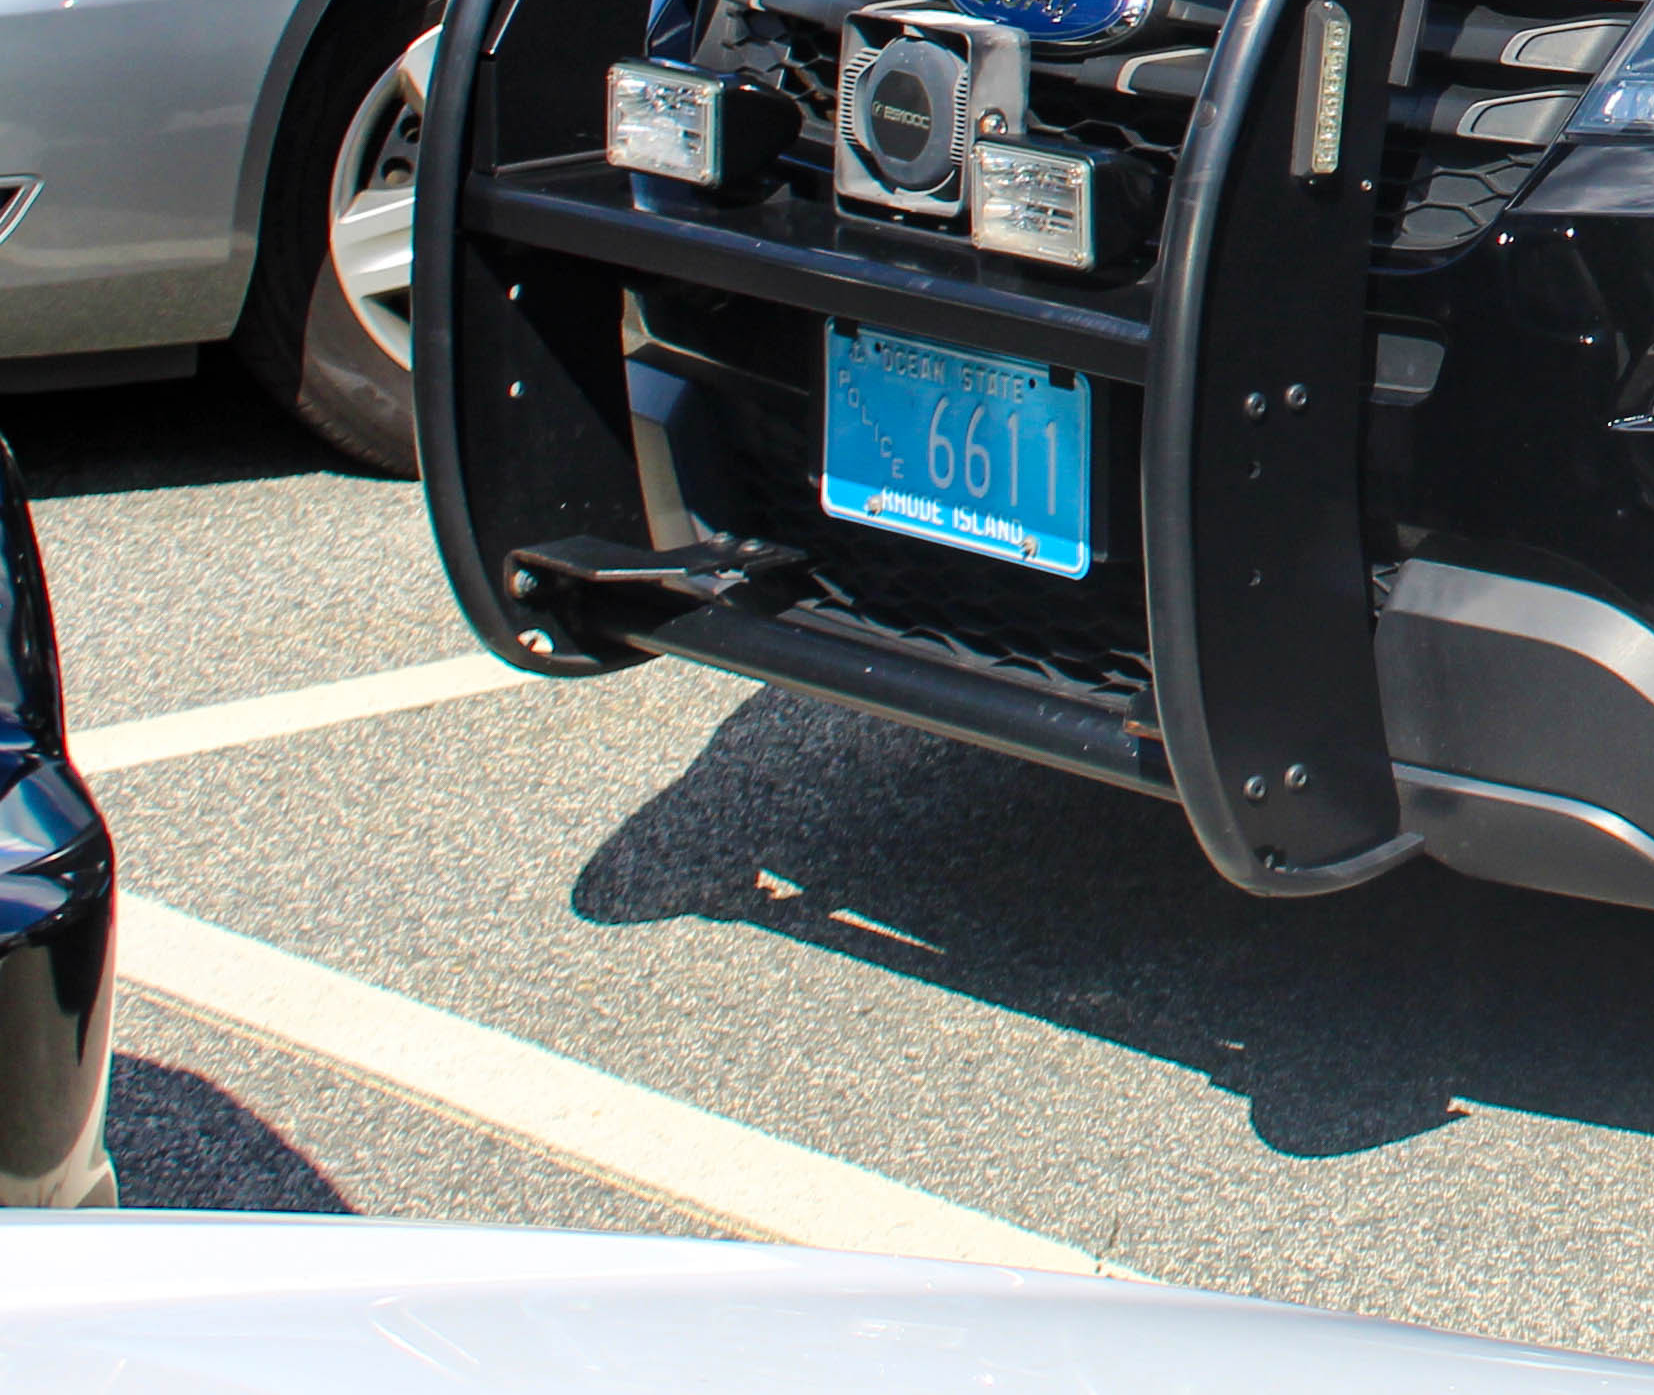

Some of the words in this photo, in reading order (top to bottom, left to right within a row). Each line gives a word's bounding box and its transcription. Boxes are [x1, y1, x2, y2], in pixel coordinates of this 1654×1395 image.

[881, 343, 946, 385] OCEAN
[961, 364, 1024, 404] STATE
[838, 369, 905, 479] POLICE
[927, 394, 1057, 517] 6611
[882, 488, 945, 526] RHODE
[951, 505, 1024, 546] ISLAND
